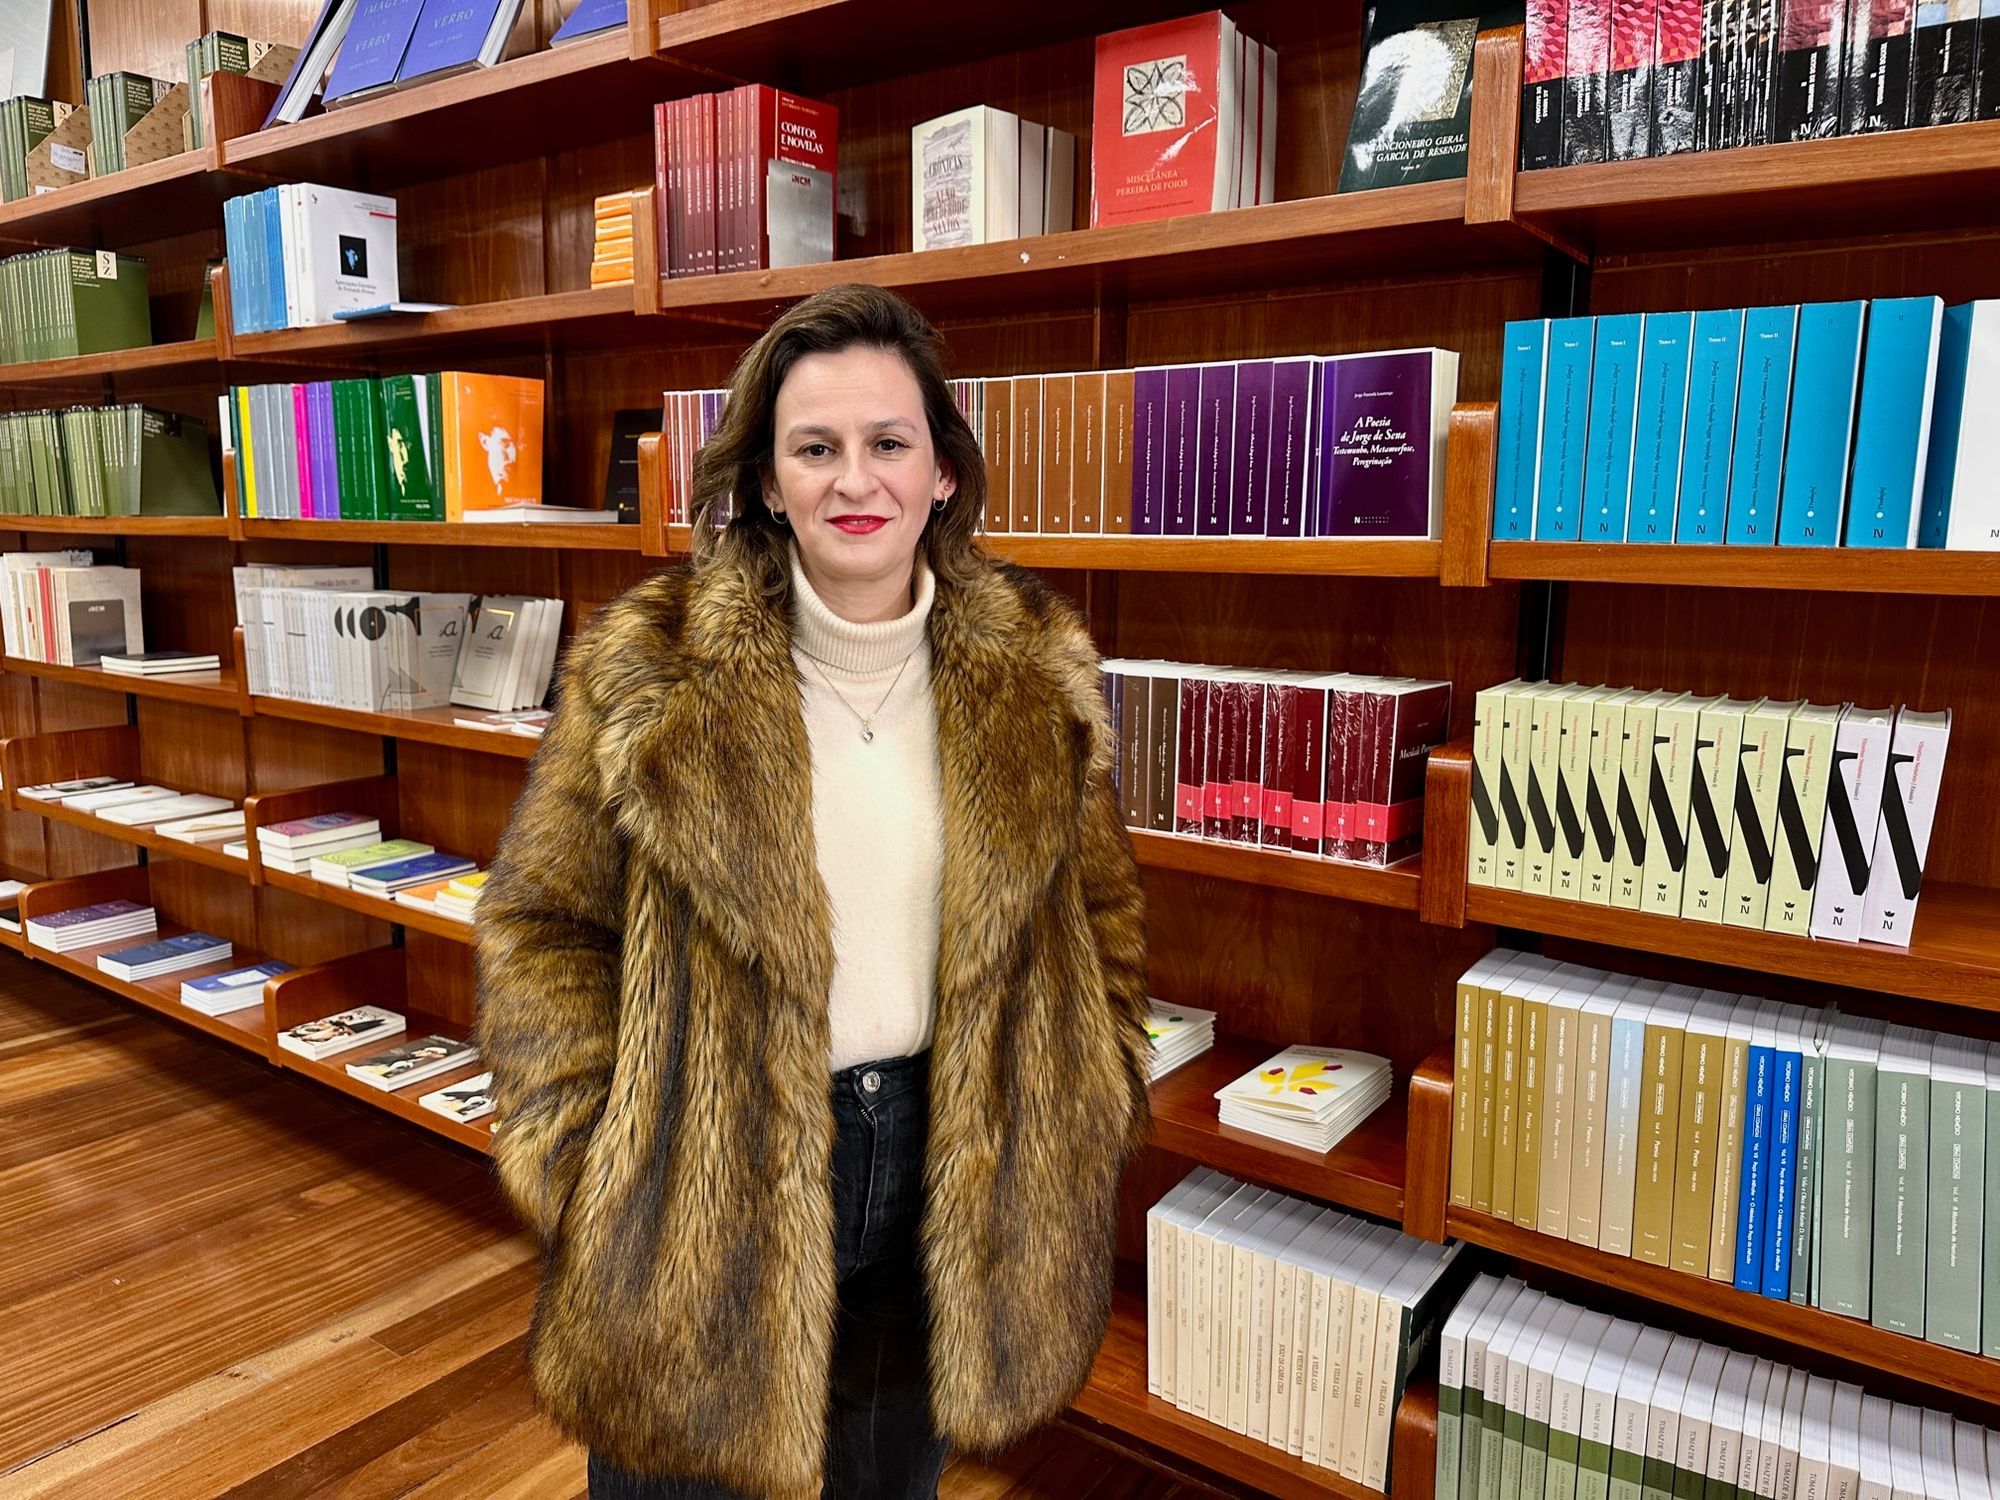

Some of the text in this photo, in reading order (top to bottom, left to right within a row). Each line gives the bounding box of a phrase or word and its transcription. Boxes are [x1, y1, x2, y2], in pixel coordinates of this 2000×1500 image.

[364, 0, 408, 16] IMAGE
[433, 9, 474, 29] VERBO
[355, 33, 391, 52] VERBO
[1536, 85, 1542, 94] DE
[1543, 89, 1548, 97] AS
[1869, 115, 1882, 127] N
[781, 122, 817, 138] CONTOS
[1800, 123, 1812, 134] N
[781, 135, 824, 154] E NOVELAS
[1370, 133, 1464, 152] ANCIONEIRO GERAL
[1377, 143, 1468, 162] GARCIA DE RESENDE
[928, 154, 963, 177] CRÓNICAS
[1126, 169, 1178, 185] MISCELÂNEA
[1116, 179, 1188, 197] PEREIRA DE FOIOS
[103, 253, 110, 265] S
[1354, 416, 1391, 428] A Poesia
[1341, 429, 1406, 445] de Jorge de Sena
[1333, 444, 1415, 455] Testemunho, Metamorfose,
[1353, 456, 1392, 469] Peregrinação
[1354, 516, 1361, 524] N
[1509, 522, 1517, 530] N
[1599, 523, 1608, 532] N
[1648, 525, 1656, 533] N
[1696, 525, 1705, 534] N
[1747, 525, 1756, 534] N
[1805, 528, 1814, 536] N
[1873, 529, 1883, 538] N
[1479, 866, 1486, 874] N
[1507, 869, 1514, 877] N
[1562, 879, 1569, 888] N
[1592, 883, 1600, 892] N
[1657, 893, 1666, 901] N
[1698, 899, 1707, 908] N
[1784, 912, 1793, 921] N
[1833, 916, 1842, 925] N
[1883, 920, 1893, 930] N
[1796, 1234, 1804, 1256] Henrique
[1278, 1357, 1284, 1365] DA
[1310, 1378, 1318, 1391] CASA
[1379, 1385, 1387, 1402] VELHA
[1353, 1394, 1361, 1407] CASA
[1377, 1402, 1385, 1416] CASA
[1657, 1441, 1663, 1449] DE
[1718, 1440, 1727, 1470] TOMAZ DE
